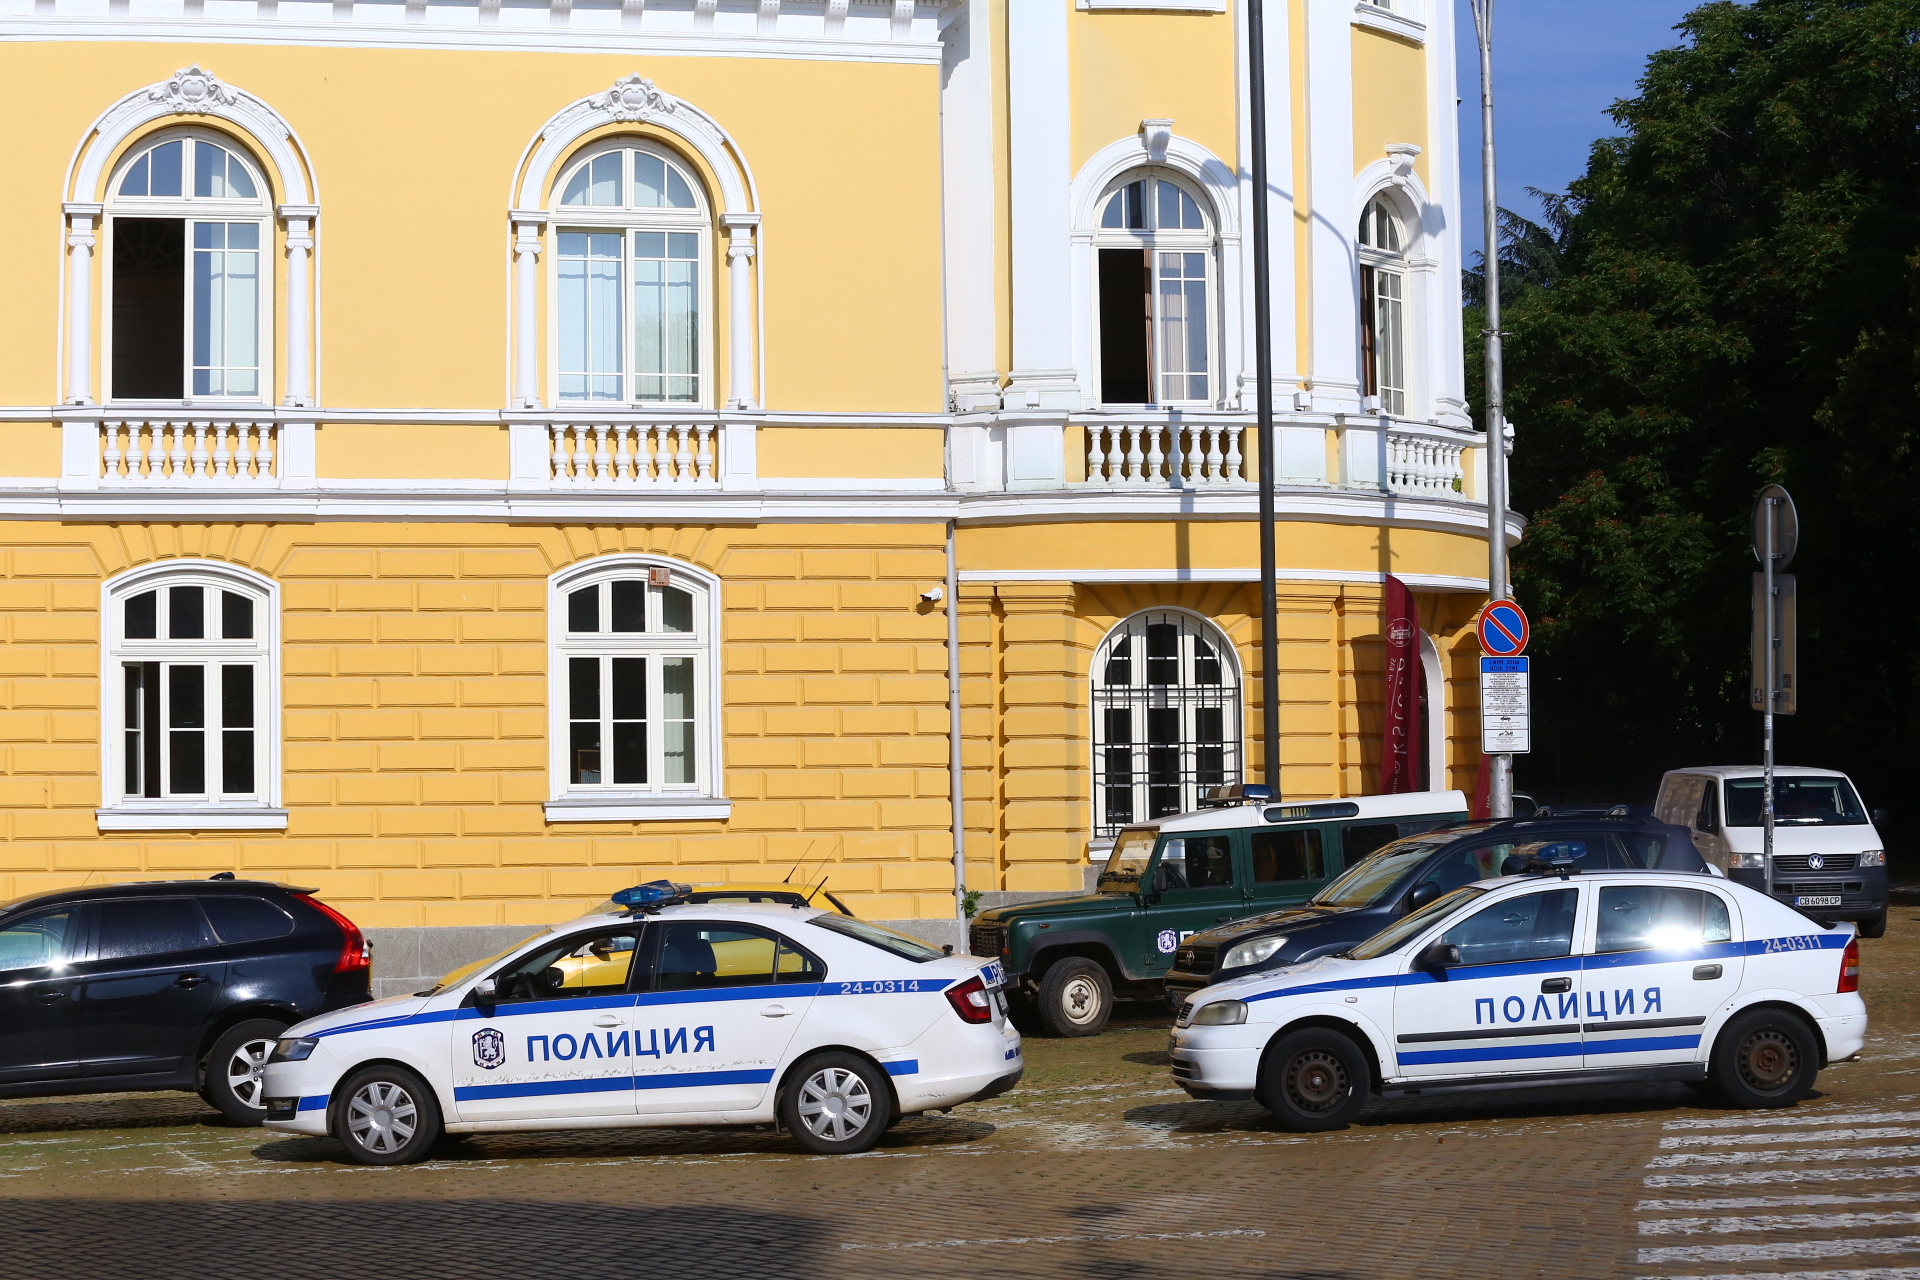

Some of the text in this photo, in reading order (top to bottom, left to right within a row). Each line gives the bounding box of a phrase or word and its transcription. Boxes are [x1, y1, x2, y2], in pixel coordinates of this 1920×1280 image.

[1811, 897, 1829, 905] 6098
[1762, 935, 1822, 954] 24-0311
[840, 980, 920, 995] 24-0314
[1475, 986, 1662, 1025] ПОЛИЦИЯ
[526, 1025, 716, 1062] ПОЛИЦИЯ
